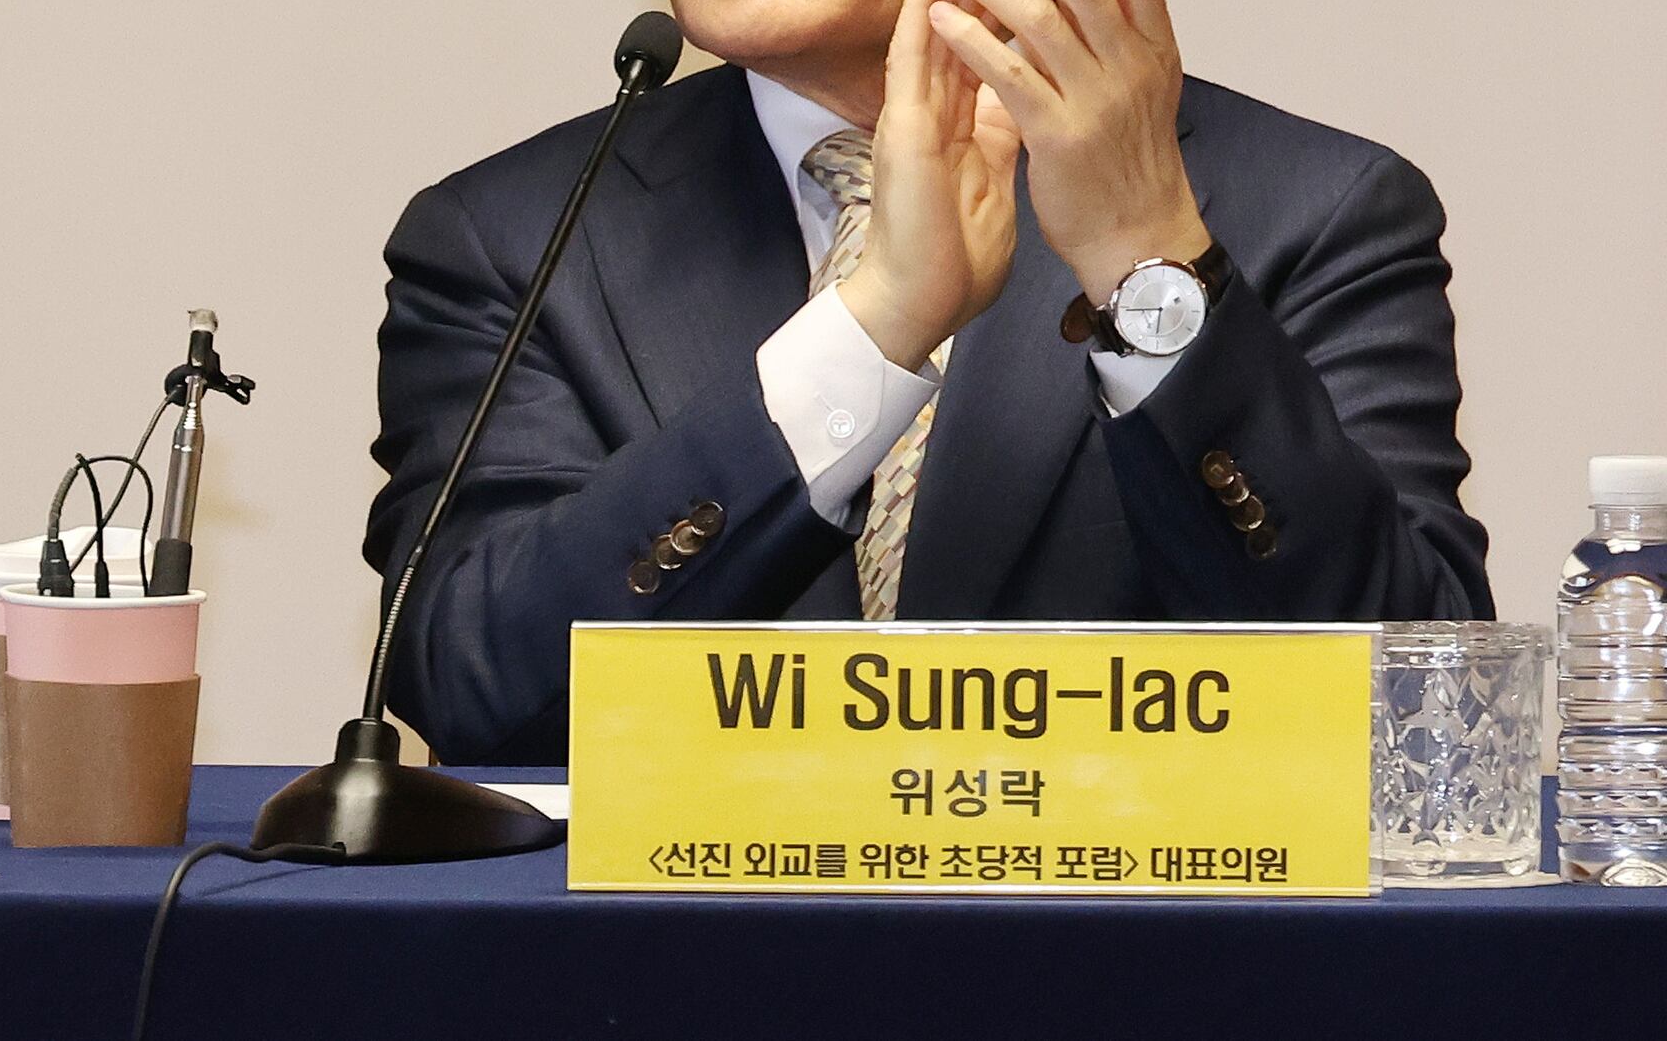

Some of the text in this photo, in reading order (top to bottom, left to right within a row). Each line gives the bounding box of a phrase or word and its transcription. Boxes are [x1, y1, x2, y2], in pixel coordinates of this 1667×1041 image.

[707, 653, 806, 729] Wi
[890, 768, 1047, 818] 위성락
[743, 843, 848, 878] 외교를
[859, 844, 930, 879] 위한
[940, 845, 1042, 880] 초당적
[1151, 847, 1289, 882] 대표의원
